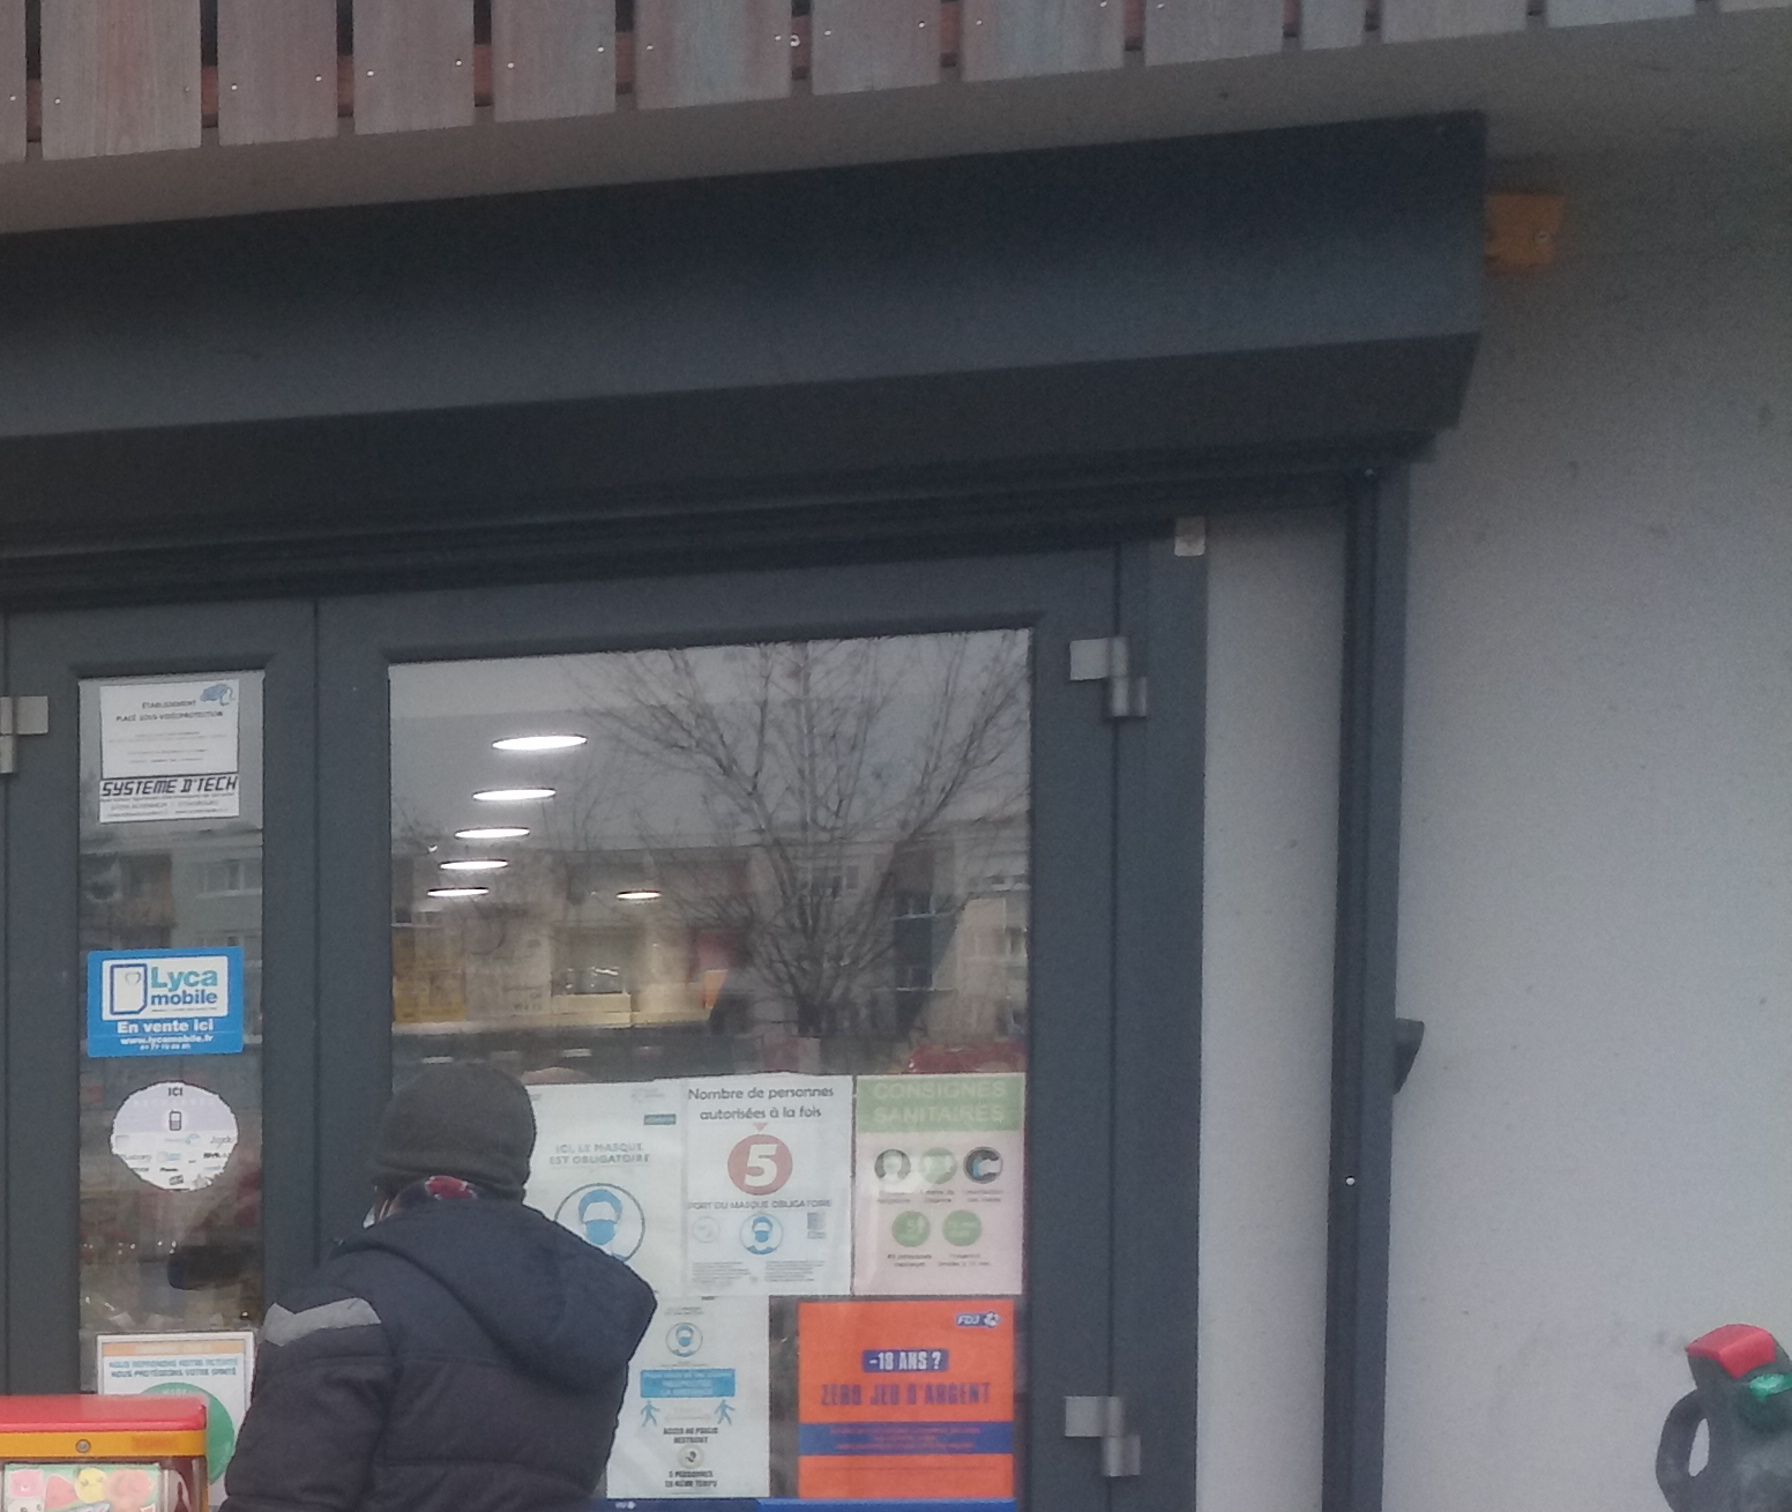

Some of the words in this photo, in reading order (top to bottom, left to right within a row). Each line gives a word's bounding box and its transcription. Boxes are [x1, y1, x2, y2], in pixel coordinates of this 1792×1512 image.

[151, 966, 217, 992] Lyca
[151, 989, 217, 1006] mobile
[117, 1021, 138, 1034] En
[143, 1020, 188, 1032] vente
[194, 1019, 214, 1031] ici
[168, 1086, 183, 1097] ICI
[688, 1088, 743, 1100] Nombre
[748, 1087, 764, 1099] de
[768, 1087, 834, 1100] personnes
[873, 1081, 1006, 1099] CONSIGNES
[700, 1107, 766, 1120] autorisées
[770, 1106, 779, 1118] à
[782, 1106, 796, 1118] la
[799, 1104, 822, 1118] fois
[874, 1105, 1004, 1123] SANITAIRES
[744, 1143, 778, 1187] 5
[869, 1352, 894, 1370] -18
[899, 1351, 927, 1370] ANS
[932, 1351, 942, 1370] ?
